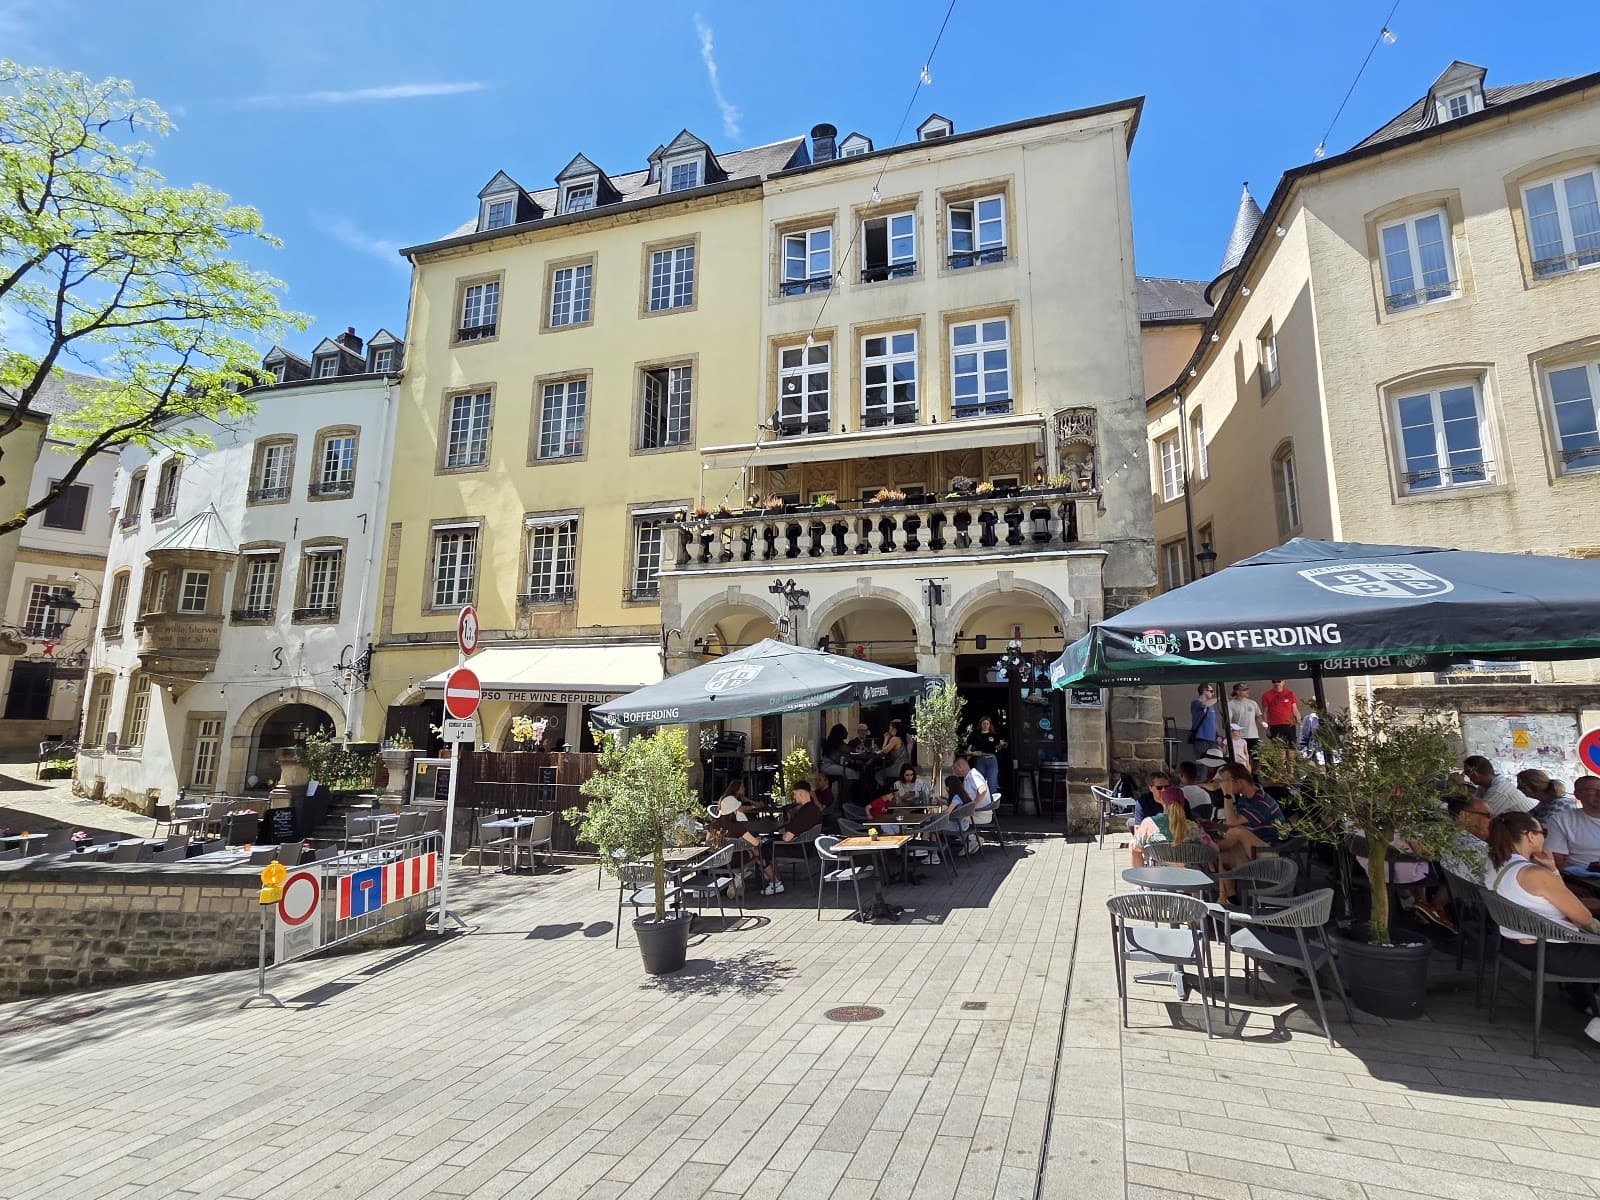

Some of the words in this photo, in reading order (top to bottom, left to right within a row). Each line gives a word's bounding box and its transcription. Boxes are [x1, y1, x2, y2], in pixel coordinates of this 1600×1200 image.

[1186, 623, 1342, 652] BOFFERDING
[481, 691, 501, 700] PSO
[508, 692, 526, 701] THE
[530, 693, 557, 702] WINE
[560, 693, 612, 703] REPUBLIC
[623, 707, 679, 723] BOFFERDING
